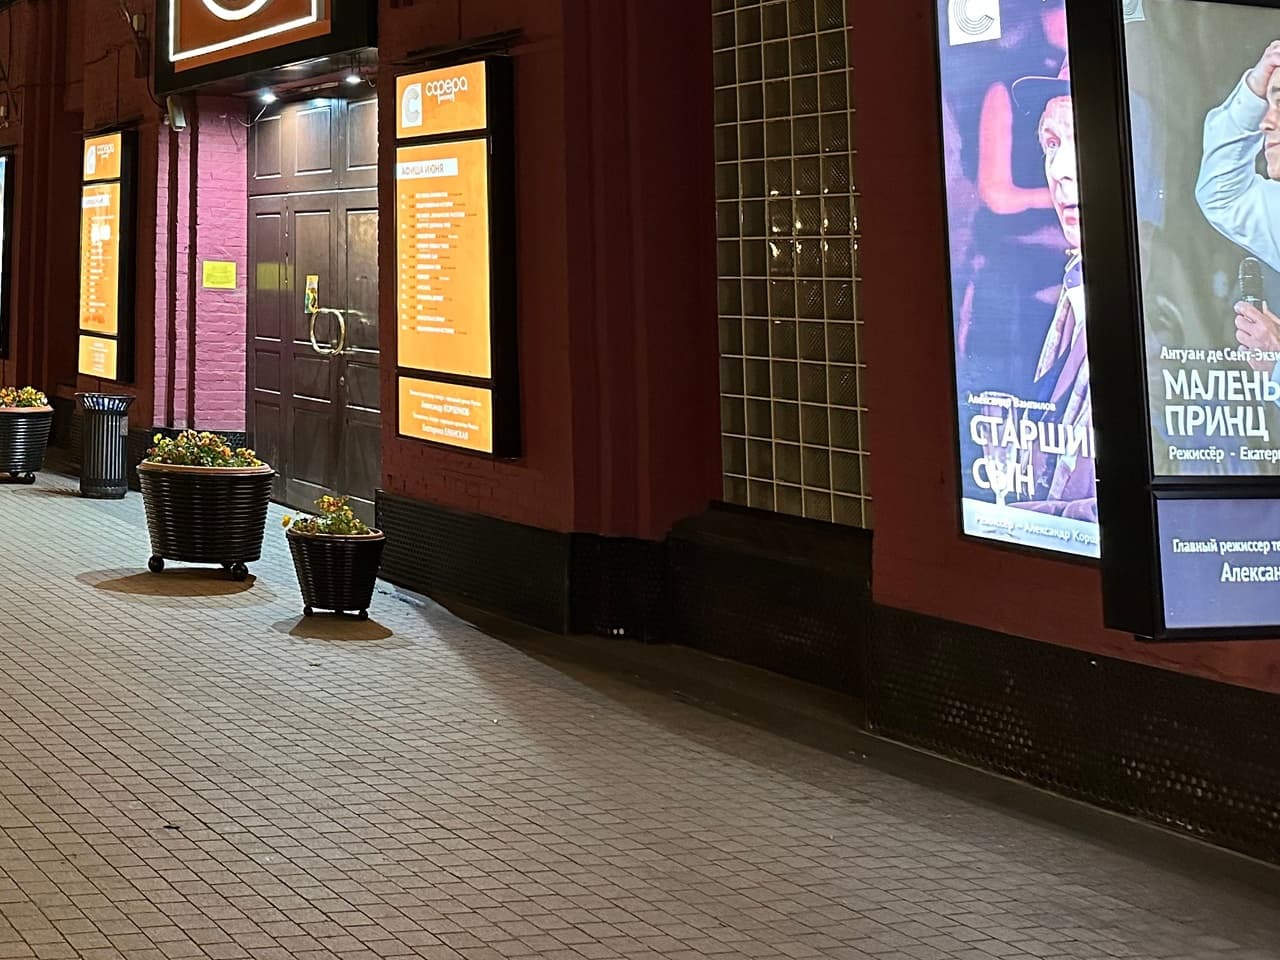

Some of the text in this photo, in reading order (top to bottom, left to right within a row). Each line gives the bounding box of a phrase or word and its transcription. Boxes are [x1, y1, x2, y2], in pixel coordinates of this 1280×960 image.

[1160, 346, 1205, 364] Антуан
[1207, 349, 1223, 363] де
[1162, 368, 1280, 402] МАЛЕНЬ
[1164, 405, 1270, 442] ПРИНЦ
[1169, 445, 1225, 463] Режиссёр
[1173, 539, 1218, 553] Главный
[1220, 541, 1270, 556] режиссер
